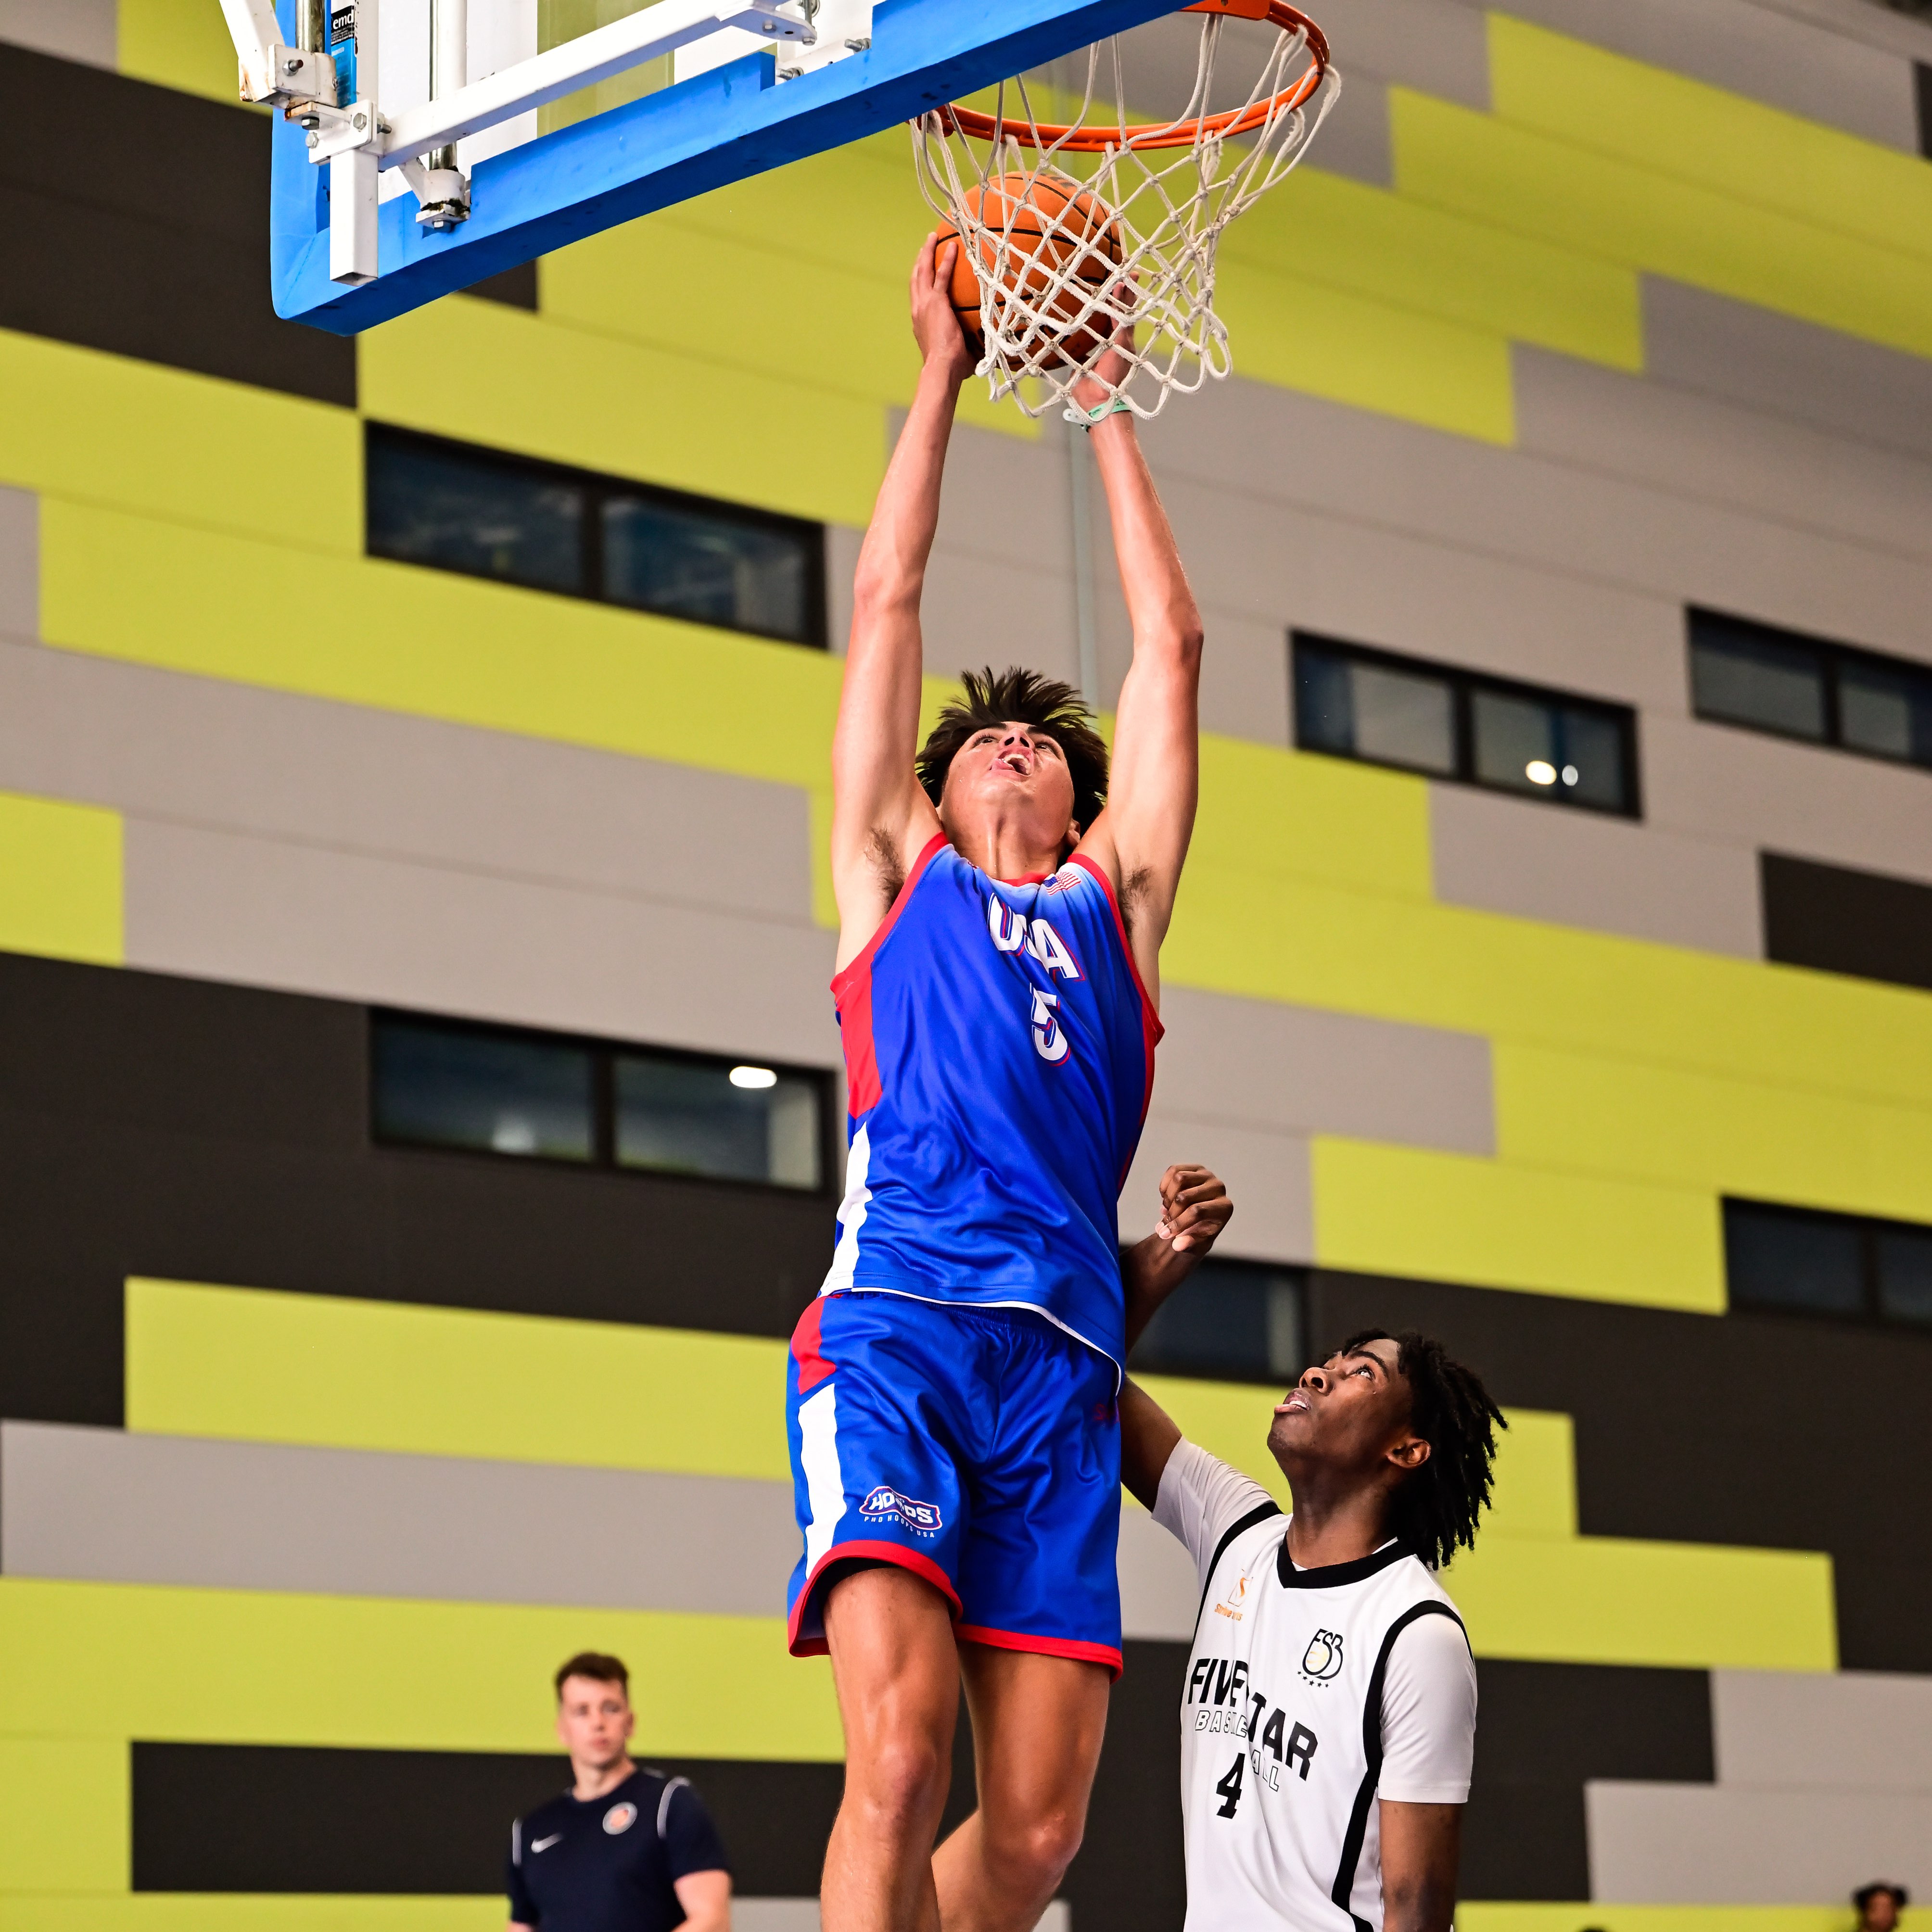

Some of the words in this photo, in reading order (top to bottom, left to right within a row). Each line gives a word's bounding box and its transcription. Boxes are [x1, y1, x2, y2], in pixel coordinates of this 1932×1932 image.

[1030, 982, 1070, 1064] 5
[868, 1492, 934, 1524] HOPS
[888, 1515, 913, 1532] HOOPS
[916, 1530, 935, 1538] USA
[1246, 1685, 1318, 1781] TAR
[1216, 1752, 1246, 1819] 4
